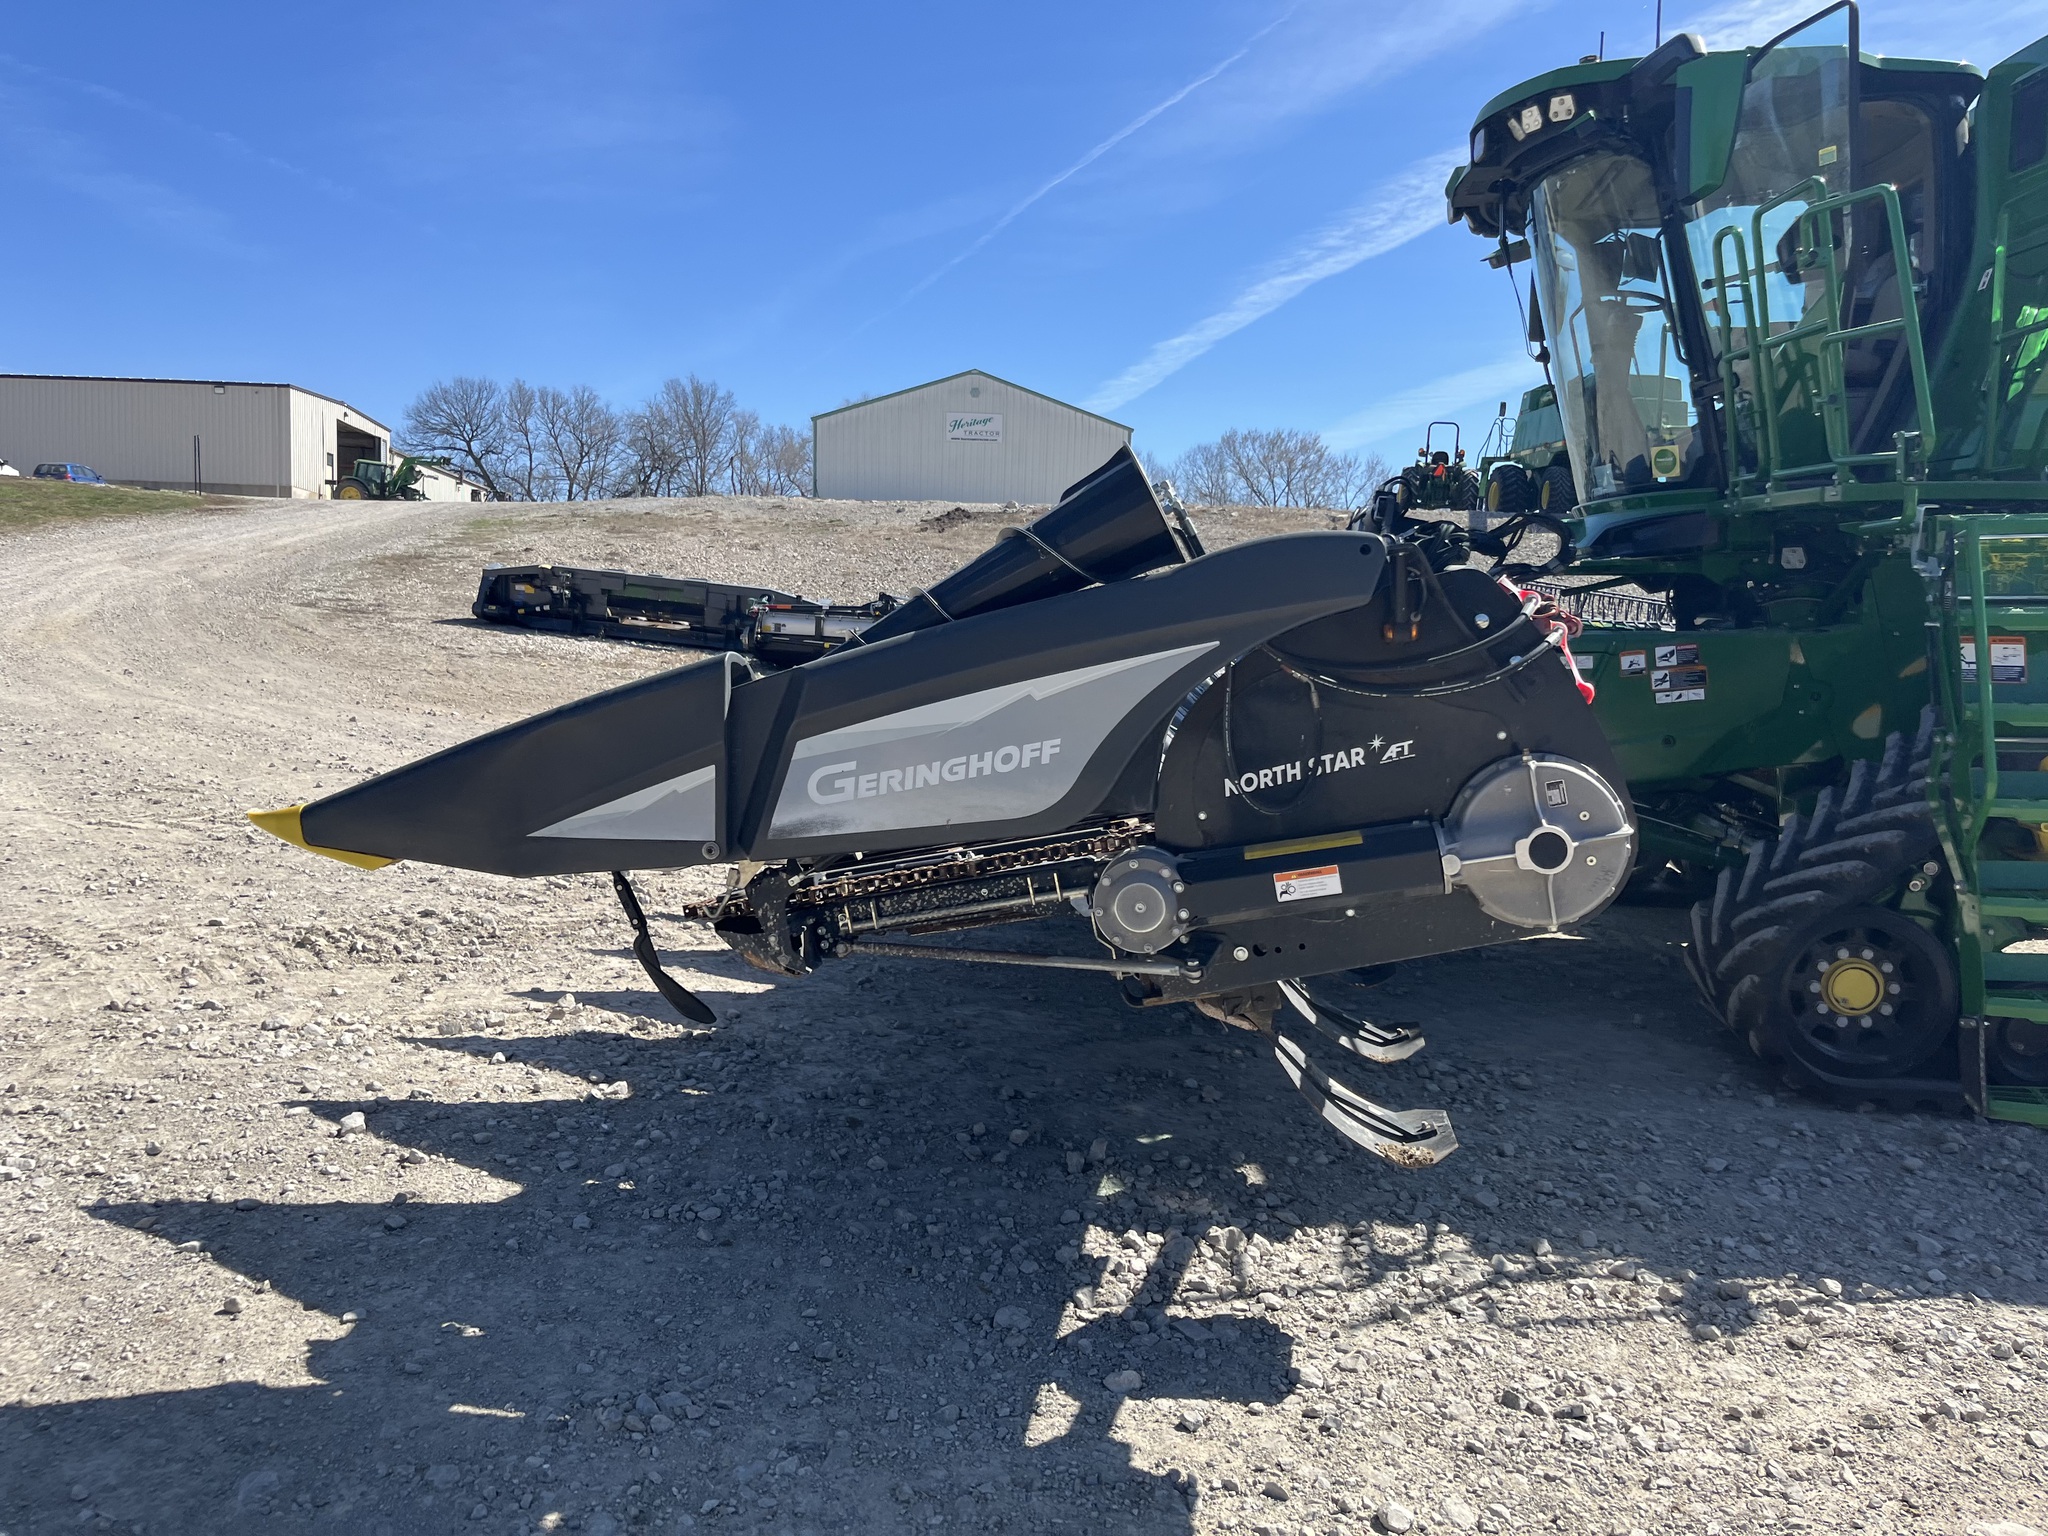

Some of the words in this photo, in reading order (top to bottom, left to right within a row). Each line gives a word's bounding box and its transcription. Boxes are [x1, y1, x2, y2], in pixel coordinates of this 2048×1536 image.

[948, 416, 994, 433] Heritage
[807, 738, 1062, 805] GERINGHOFF
[1224, 760, 1301, 797] NORTH
[1380, 739, 1415, 763] AFT
